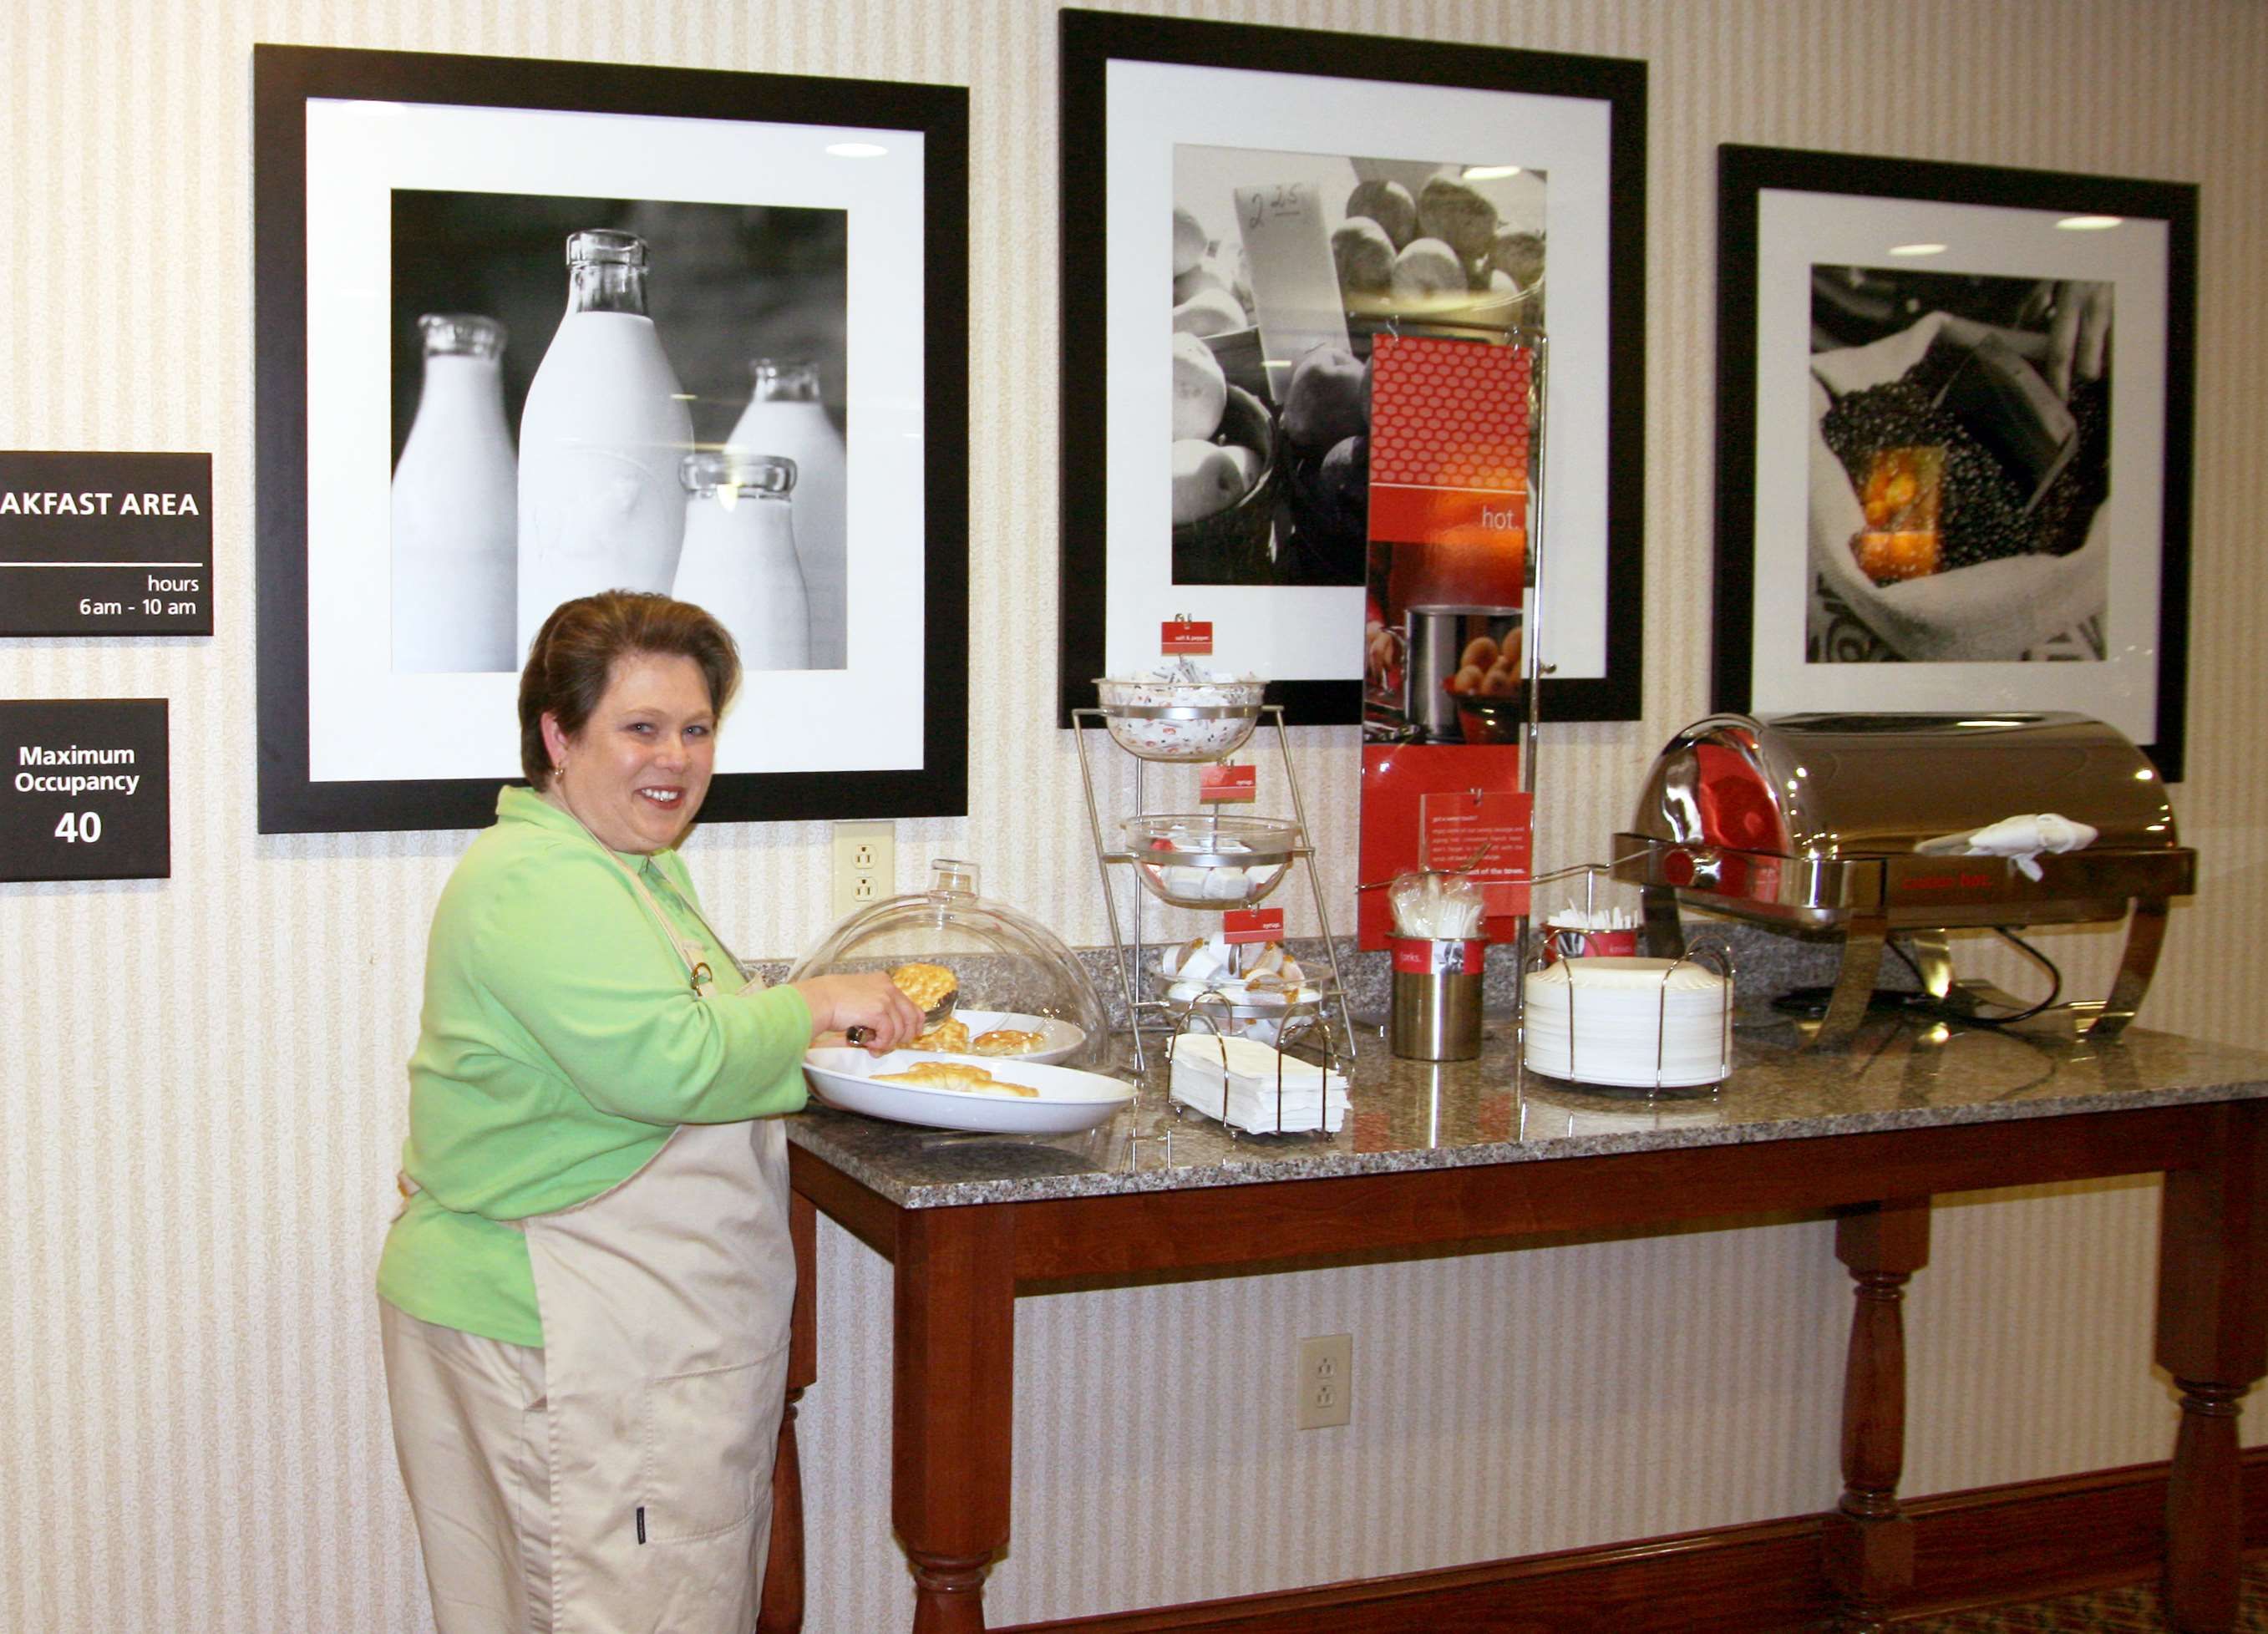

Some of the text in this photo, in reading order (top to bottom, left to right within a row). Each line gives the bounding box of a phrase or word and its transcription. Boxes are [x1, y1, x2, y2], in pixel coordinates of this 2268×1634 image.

[0, 492, 200, 515] AKFAST AREA
[148, 574, 200, 591] hours
[79, 598, 122, 615] 6am
[142, 598, 162, 615] 10
[168, 602, 196, 615] am
[19, 745, 135, 766] Maximum
[14, 772, 140, 796] Occupancy
[54, 811, 102, 843] 40
